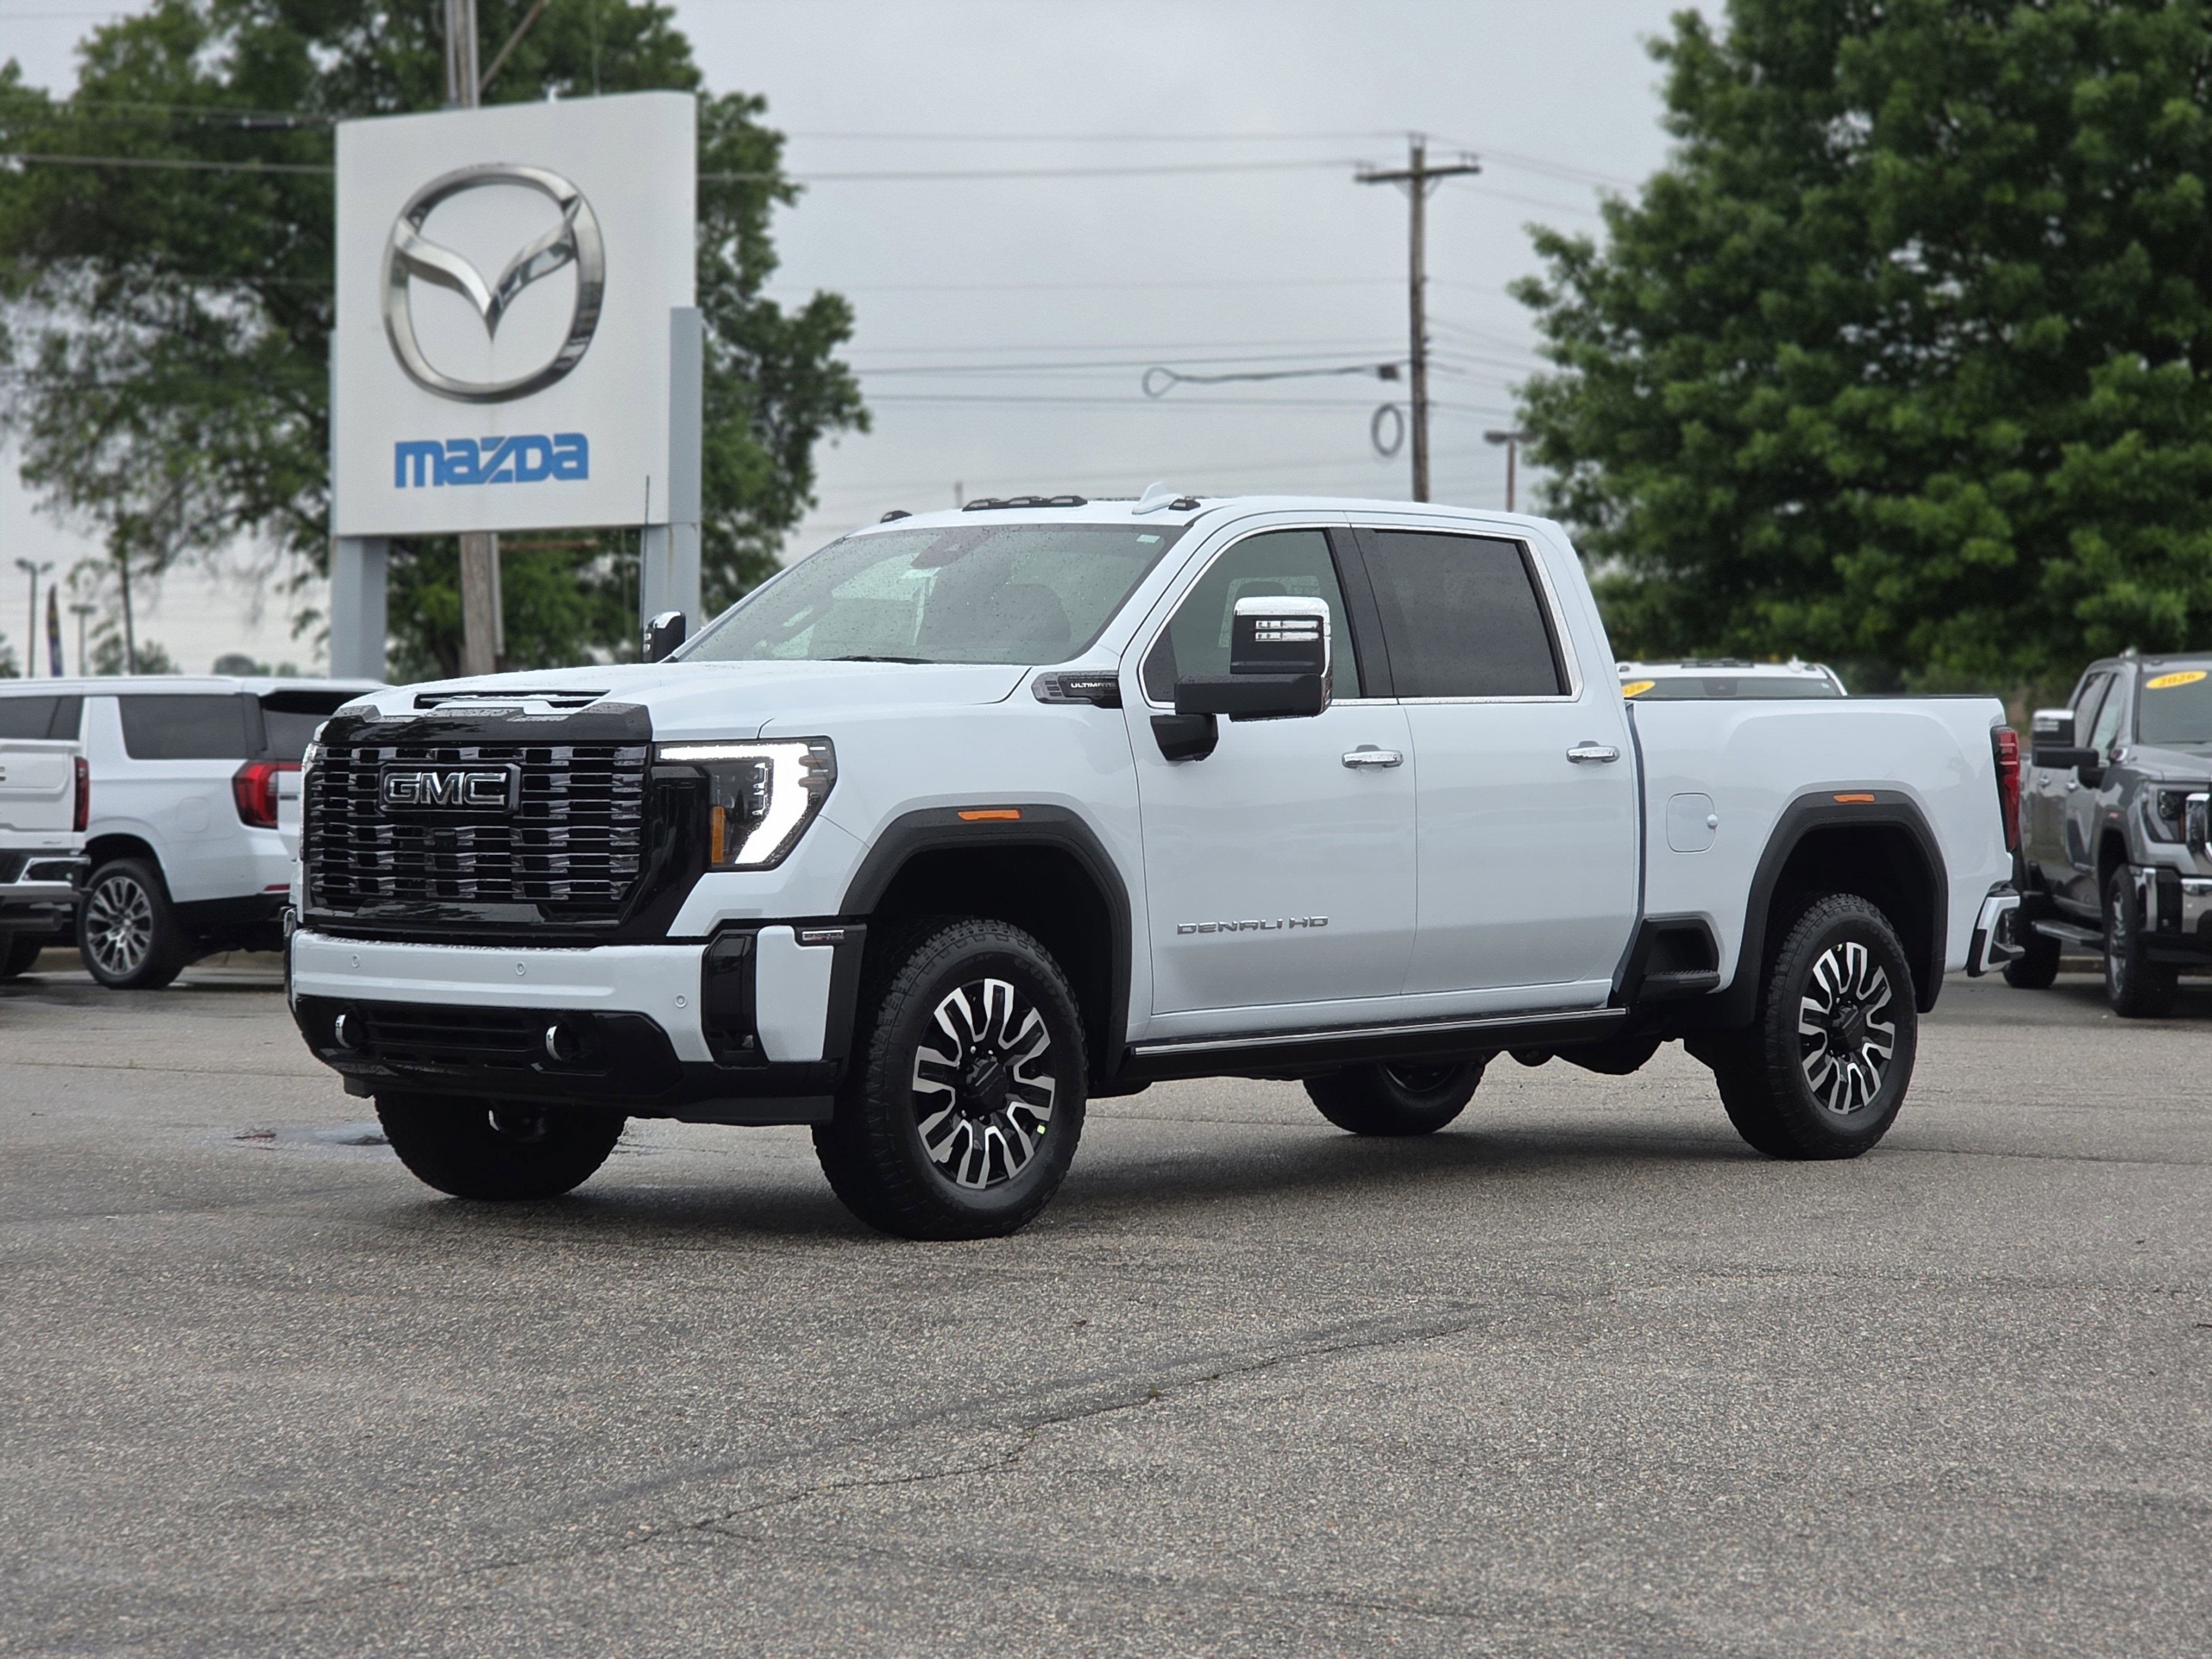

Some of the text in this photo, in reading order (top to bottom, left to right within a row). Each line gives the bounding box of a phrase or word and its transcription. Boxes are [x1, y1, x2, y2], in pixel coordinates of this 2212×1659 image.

[384, 772, 507, 805] GMC
[1177, 916, 1328, 935] DENALI HD
